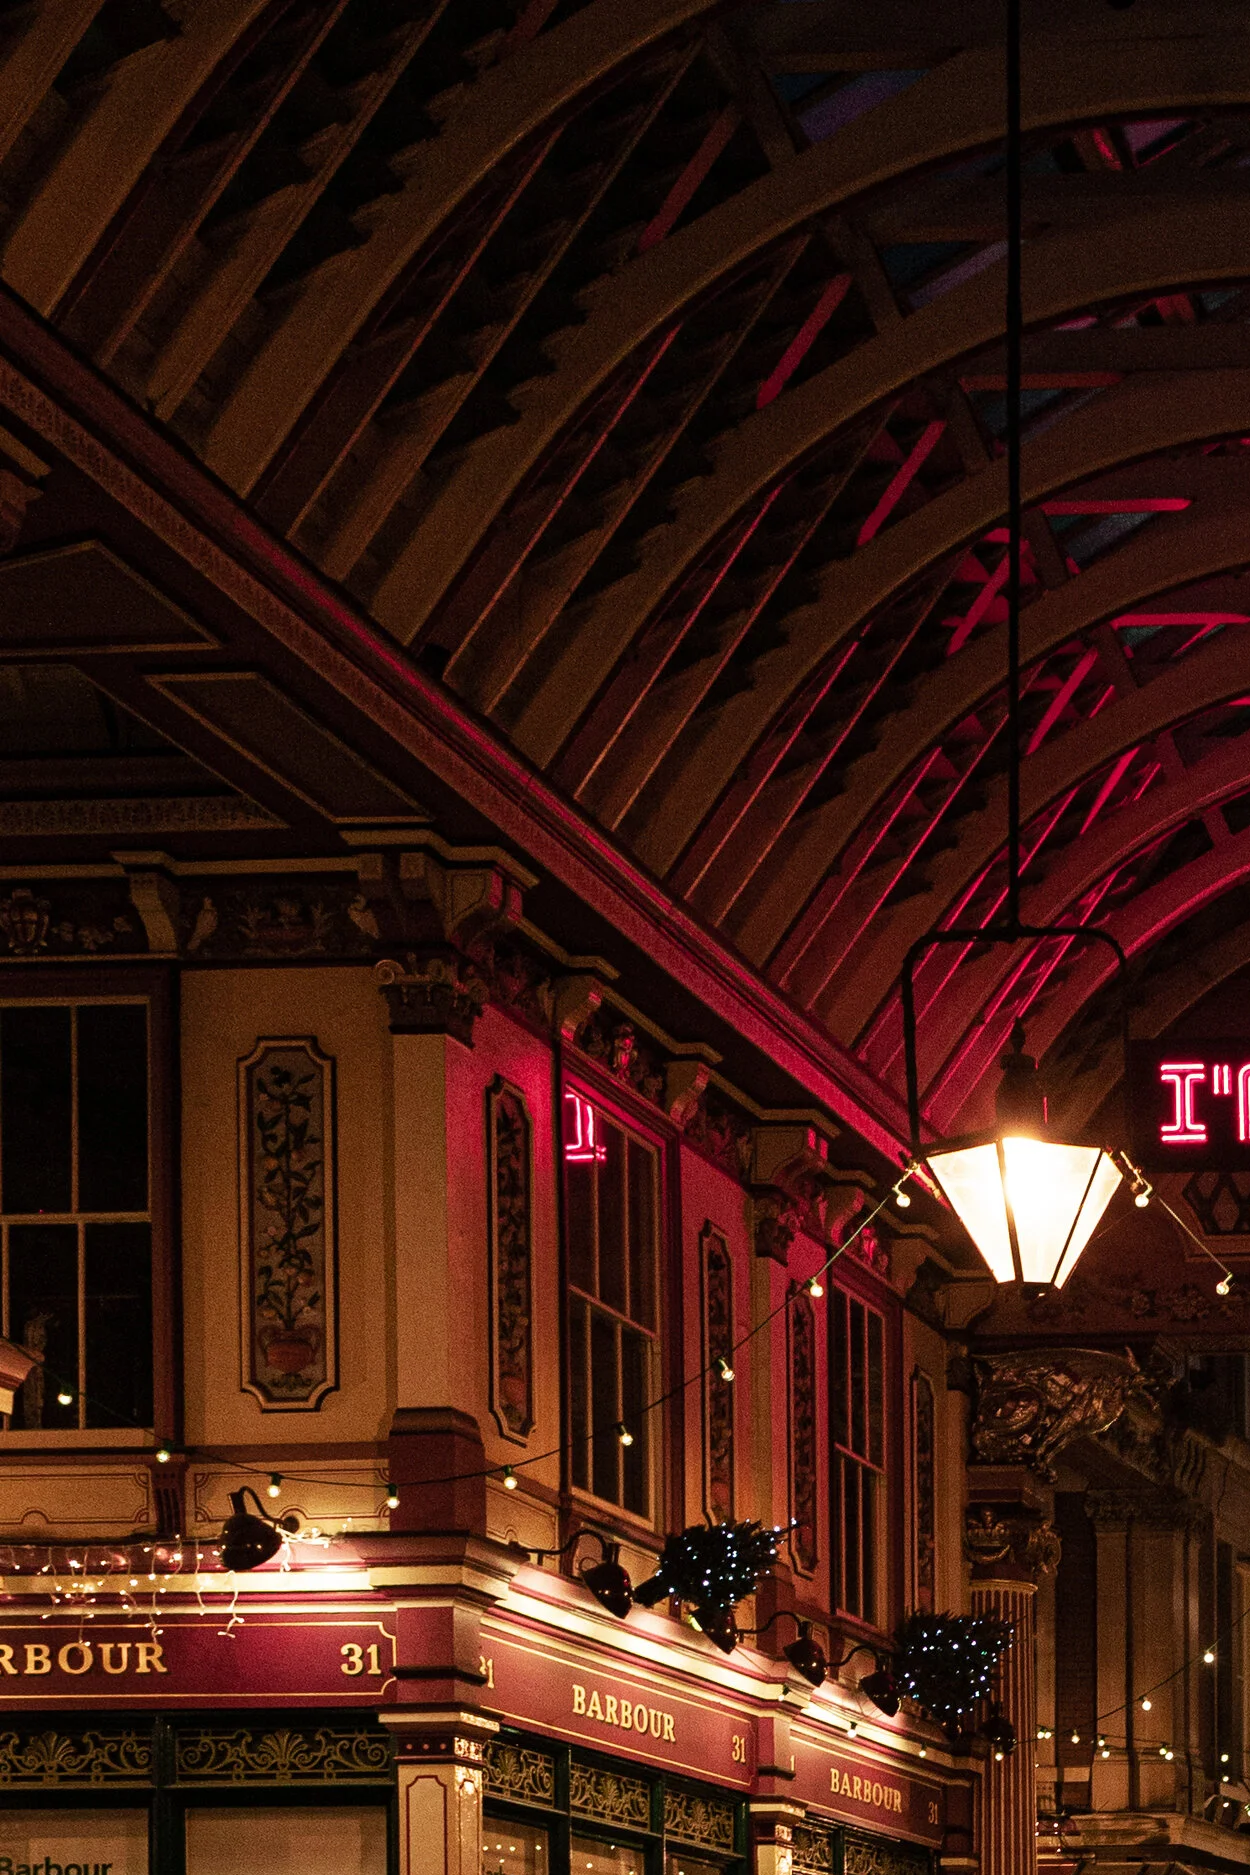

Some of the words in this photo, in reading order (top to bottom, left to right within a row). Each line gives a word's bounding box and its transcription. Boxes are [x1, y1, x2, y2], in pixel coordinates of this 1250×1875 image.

[340, 1643, 382, 1676] 31
[572, 1684, 676, 1743] BARBOUR
[731, 1735, 746, 1763] 31
[830, 1768, 903, 1813] BARBOUR
[927, 1801, 939, 1825] 31
